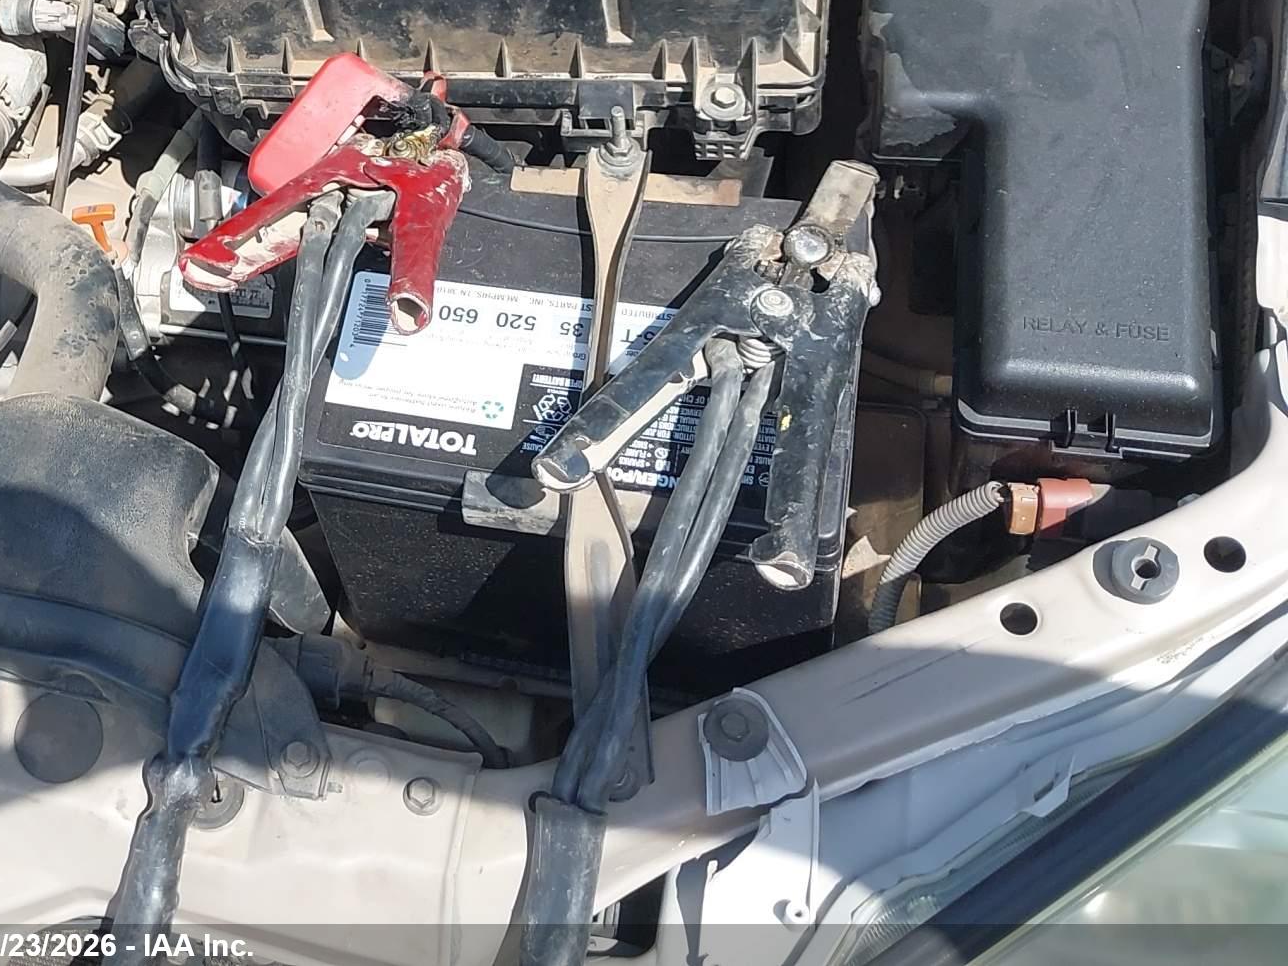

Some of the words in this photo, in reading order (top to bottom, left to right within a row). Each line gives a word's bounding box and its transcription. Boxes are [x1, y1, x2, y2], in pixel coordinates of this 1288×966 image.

[439, 305, 478, 324] 650
[496, 312, 536, 331] 520
[560, 321, 584, 337] 35
[1023, 316, 1087, 334] RELAY
[1095, 321, 1108, 336] &
[1116, 322, 1170, 341] FUSE
